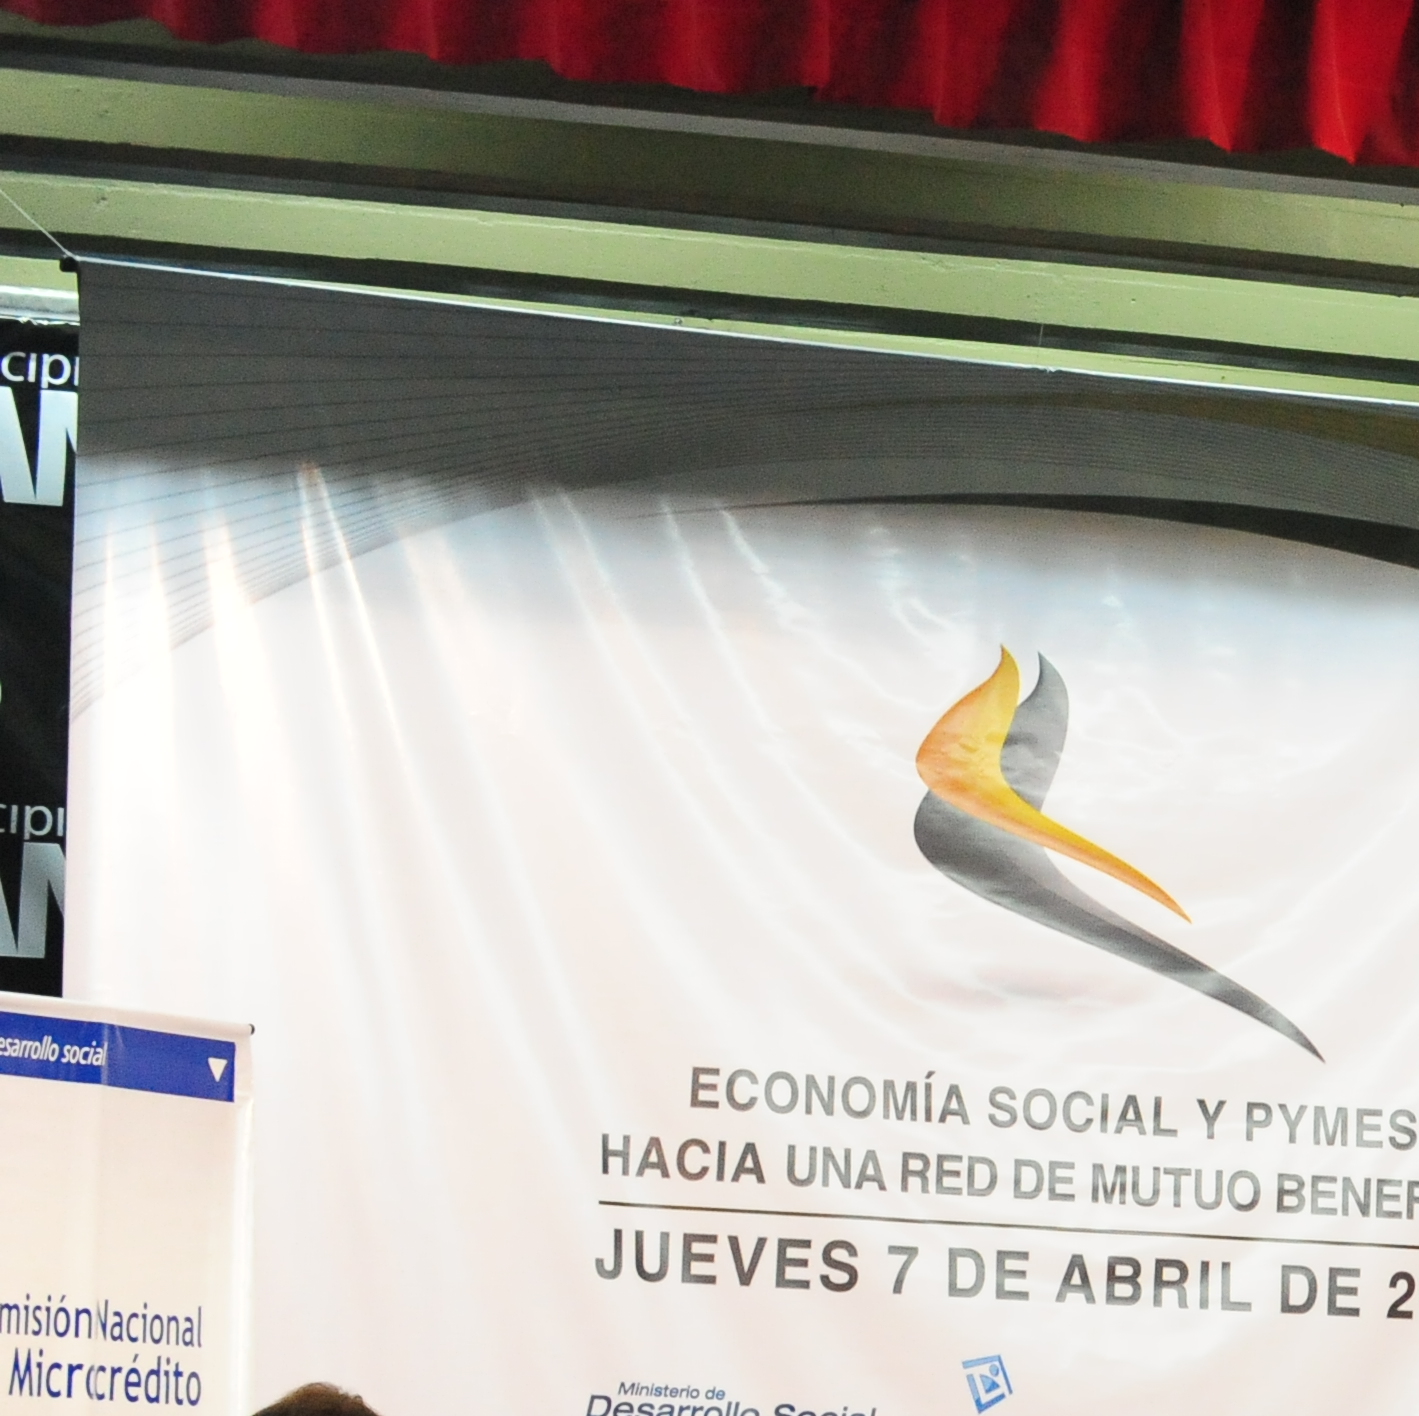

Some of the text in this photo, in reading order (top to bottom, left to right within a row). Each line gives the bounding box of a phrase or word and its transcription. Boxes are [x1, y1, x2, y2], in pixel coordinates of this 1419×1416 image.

[61, 1040, 108, 1067] social
[689, 1066, 971, 1126] ECONOMÍA
[988, 1086, 1179, 1138] SOCIAL
[1196, 1098, 1227, 1140] Y
[600, 1132, 766, 1185] HACIA
[786, 1143, 888, 1192] UNA
[899, 1151, 999, 1198] RED
[1013, 1158, 1076, 1202] DE
[1090, 1162, 1262, 1213] MUTUO
[594, 1228, 860, 1292] JUEVES
[886, 1244, 920, 1295] 7
[947, 1246, 1030, 1301] DE
[1054, 1252, 1253, 1312] ABRIL
[1279, 1263, 1361, 1318] DE
[95, 1298, 202, 1349] Nacional
[617, 1381, 726, 1401] Ministerio de
